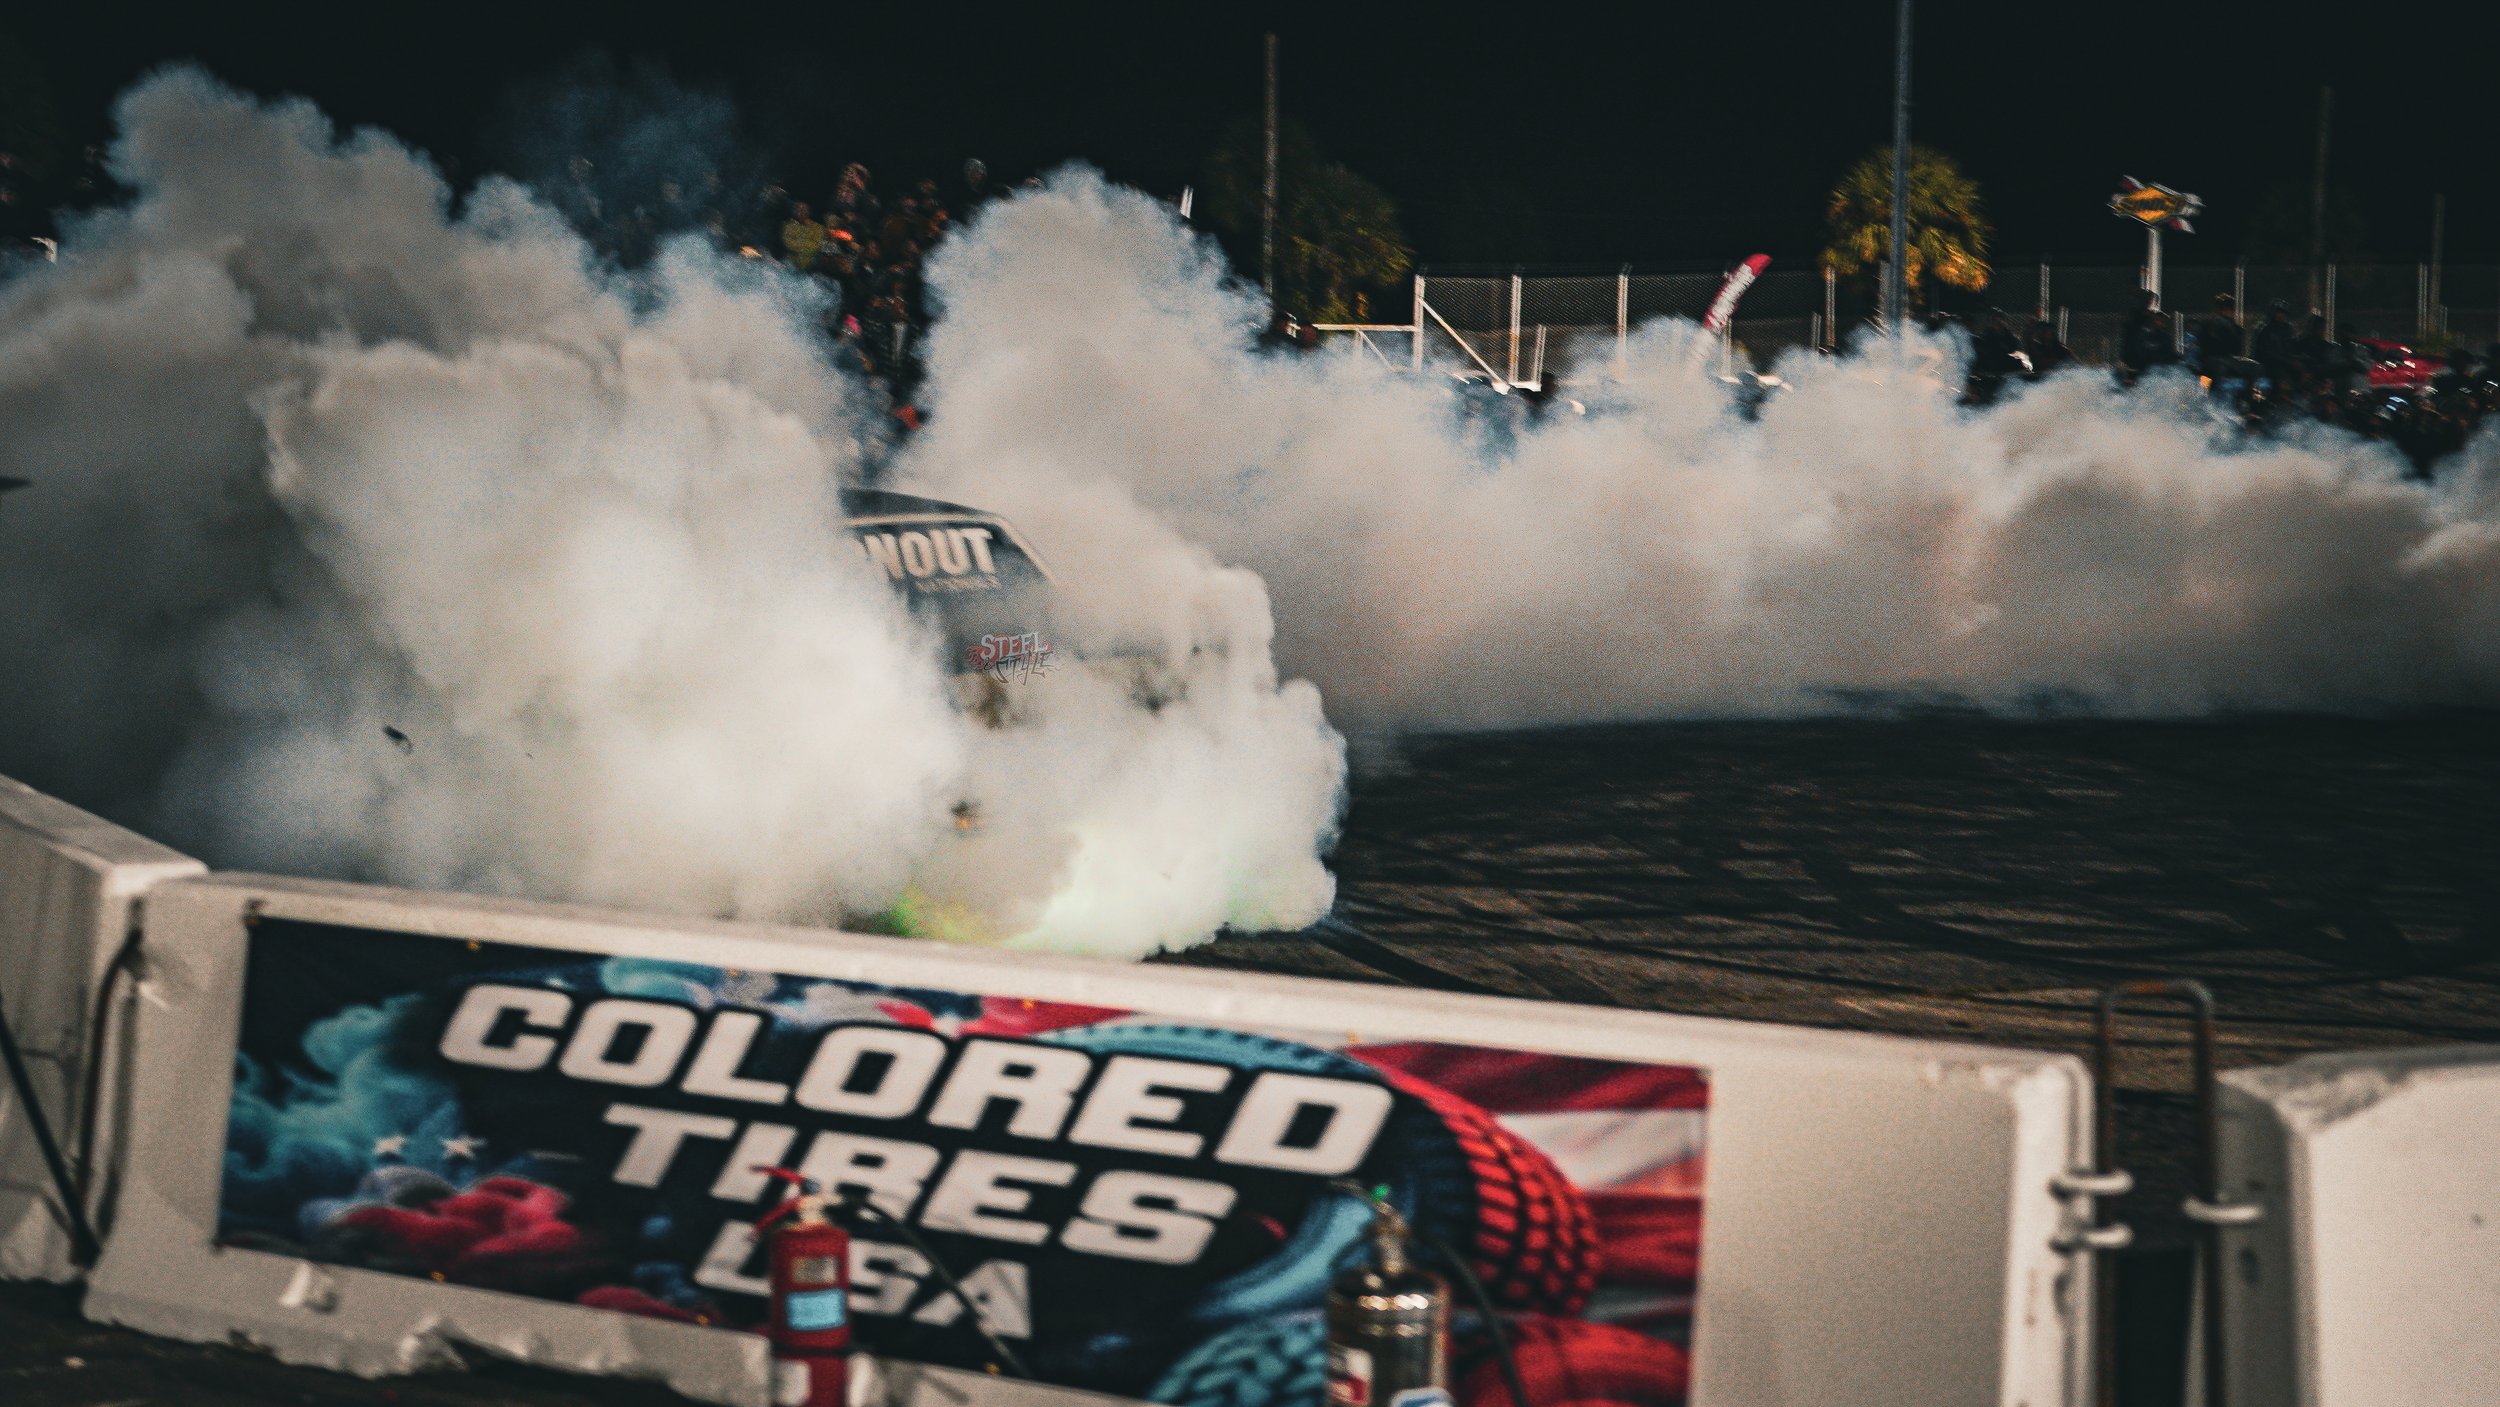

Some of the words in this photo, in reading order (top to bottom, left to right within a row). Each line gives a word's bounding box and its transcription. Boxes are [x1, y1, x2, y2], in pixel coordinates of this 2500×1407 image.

[856, 527, 995, 580] NOUT
[438, 983, 1395, 1176] COLORED
[603, 1103, 1238, 1265] TIRES
